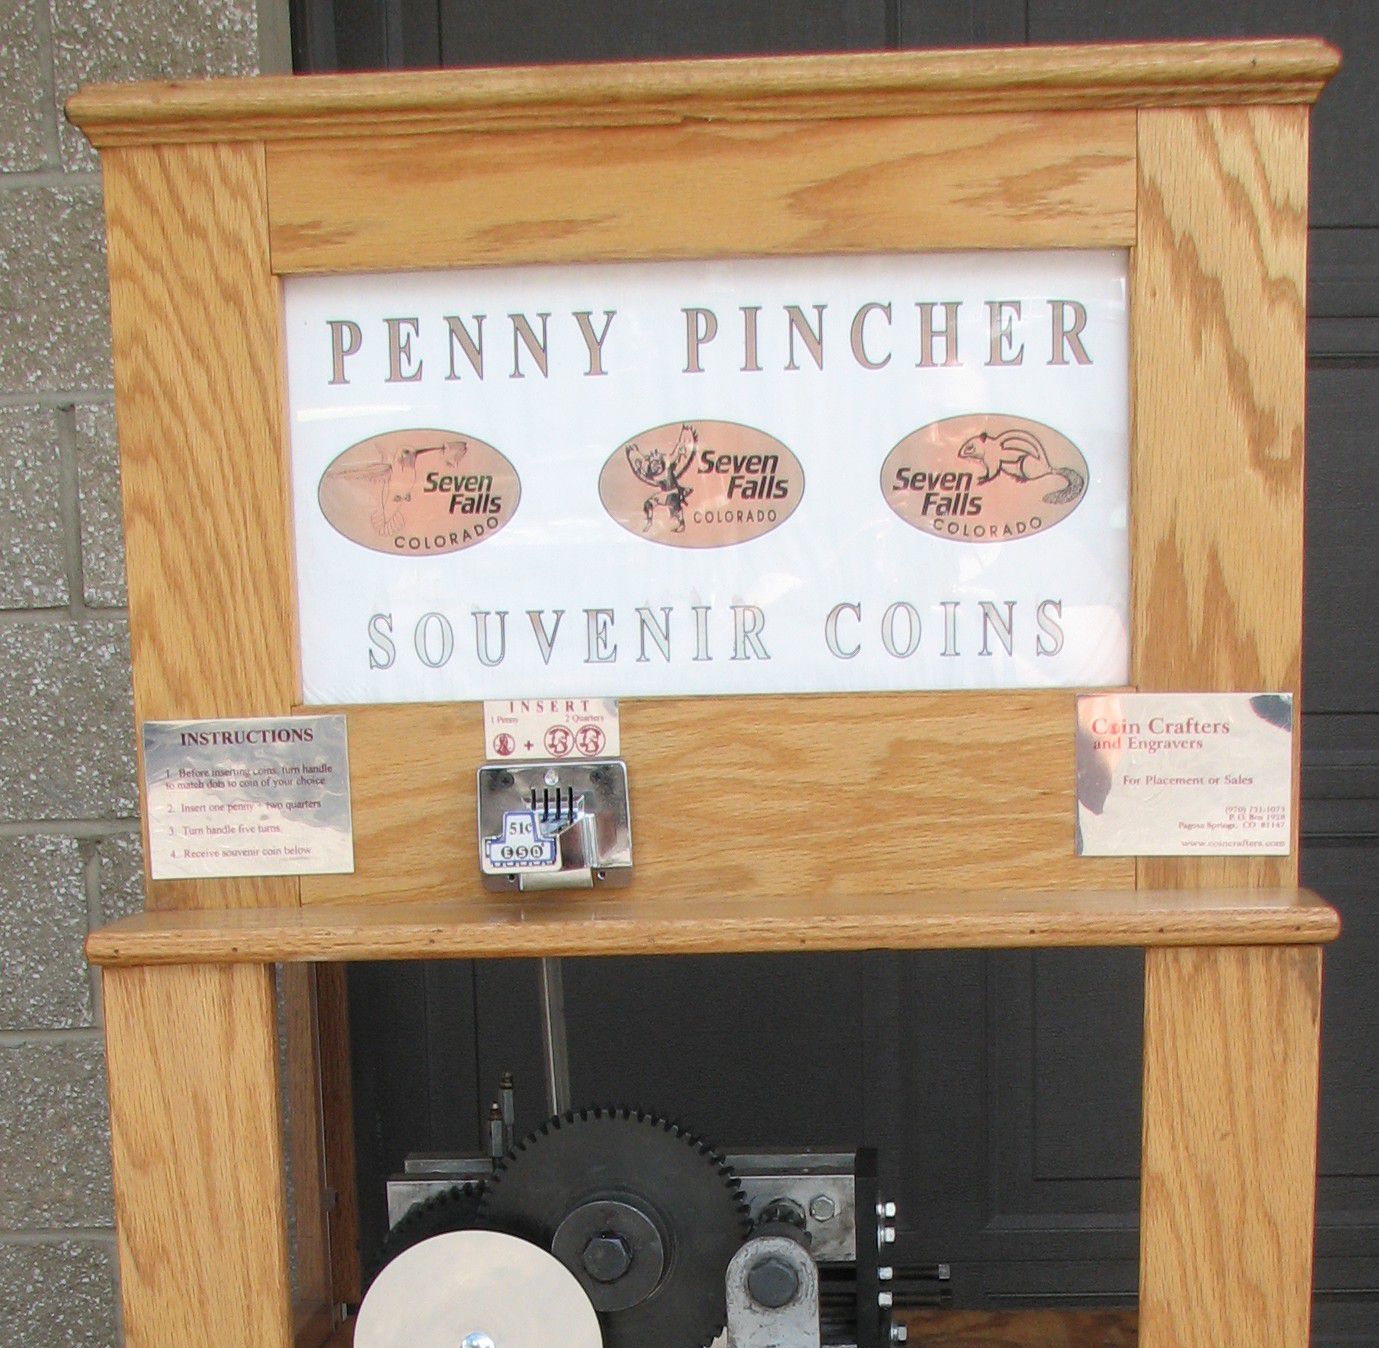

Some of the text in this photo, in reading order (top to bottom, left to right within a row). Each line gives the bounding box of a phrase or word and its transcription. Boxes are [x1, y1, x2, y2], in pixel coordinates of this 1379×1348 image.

[326, 299, 1094, 385] PENNY PINCHER
[697, 450, 779, 474] Seven
[423, 472, 493, 493] Seven
[727, 474, 789, 500] Falls
[892, 467, 973, 492] Seven
[448, 493, 502, 515] Falls
[921, 492, 983, 516] Falls
[694, 509, 777, 524] COLORADO
[394, 516, 499, 550] COLORADO
[933, 516, 1042, 538] COLORADO
[367, 599, 1064, 670] SOUVENIR COINS
[508, 700, 590, 713] INSERT
[565, 713, 605, 723] 2 Quarters
[1091, 717, 1230, 735] Coin Crafters
[180, 727, 314, 747] INSTRUCTIONS
[1093, 736, 1204, 753] and Engravers
[178, 768, 209, 778] Before
[281, 766, 300, 775] turn
[302, 764, 333, 774] handle
[1122, 774, 1254, 786] For Placement or Sales
[166, 776, 326, 790] to match dots to coin of your choice
[181, 802, 206, 813] Insert
[208, 804, 225, 812] one
[227, 802, 254, 815] penny
[266, 800, 284, 810] two
[285, 799, 322, 811] quarters
[183, 826, 204, 836] Turn
[206, 824, 236, 835] handle
[238, 823, 256, 834] five
[257, 824, 281, 834] turns
[184, 848, 220, 859] Receive
[221, 847, 260, 858] souvenir
[262, 846, 282, 857] coin
[283, 845, 312, 856] below
[1181, 839, 1285, 848] www.coincrafters.com
